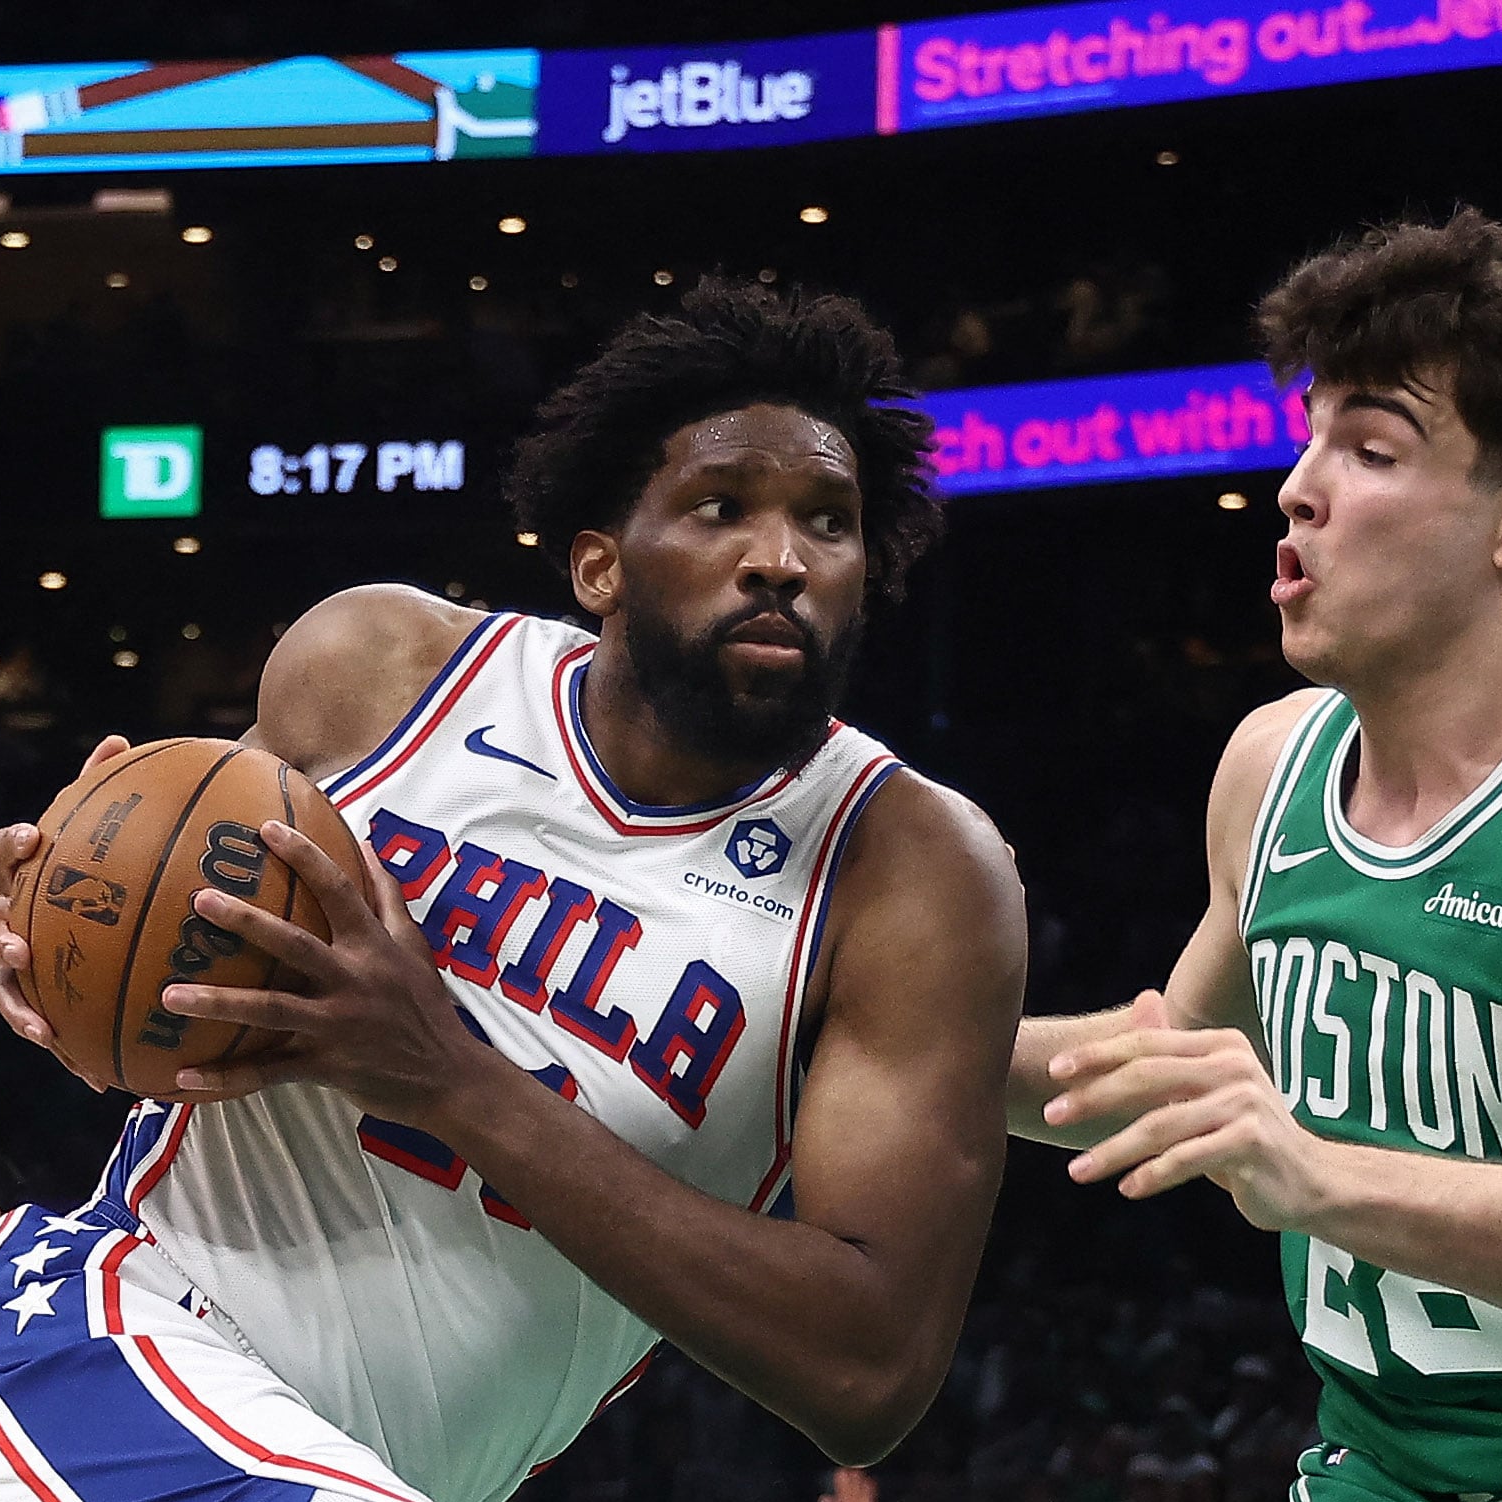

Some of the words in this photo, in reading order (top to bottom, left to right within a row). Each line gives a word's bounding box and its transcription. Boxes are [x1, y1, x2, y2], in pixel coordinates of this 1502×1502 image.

[912, 11, 1251, 103] Stretching
[602, 60, 813, 144] jetBlue
[249, 443, 368, 495] 8:17
[376, 441, 464, 492] PM
[1011, 404, 1124, 470] out
[1129, 386, 1275, 460] with
[111, 441, 194, 500] TD
[683, 872, 794, 920] crypto.com
[369, 807, 746, 1130] PHILA
